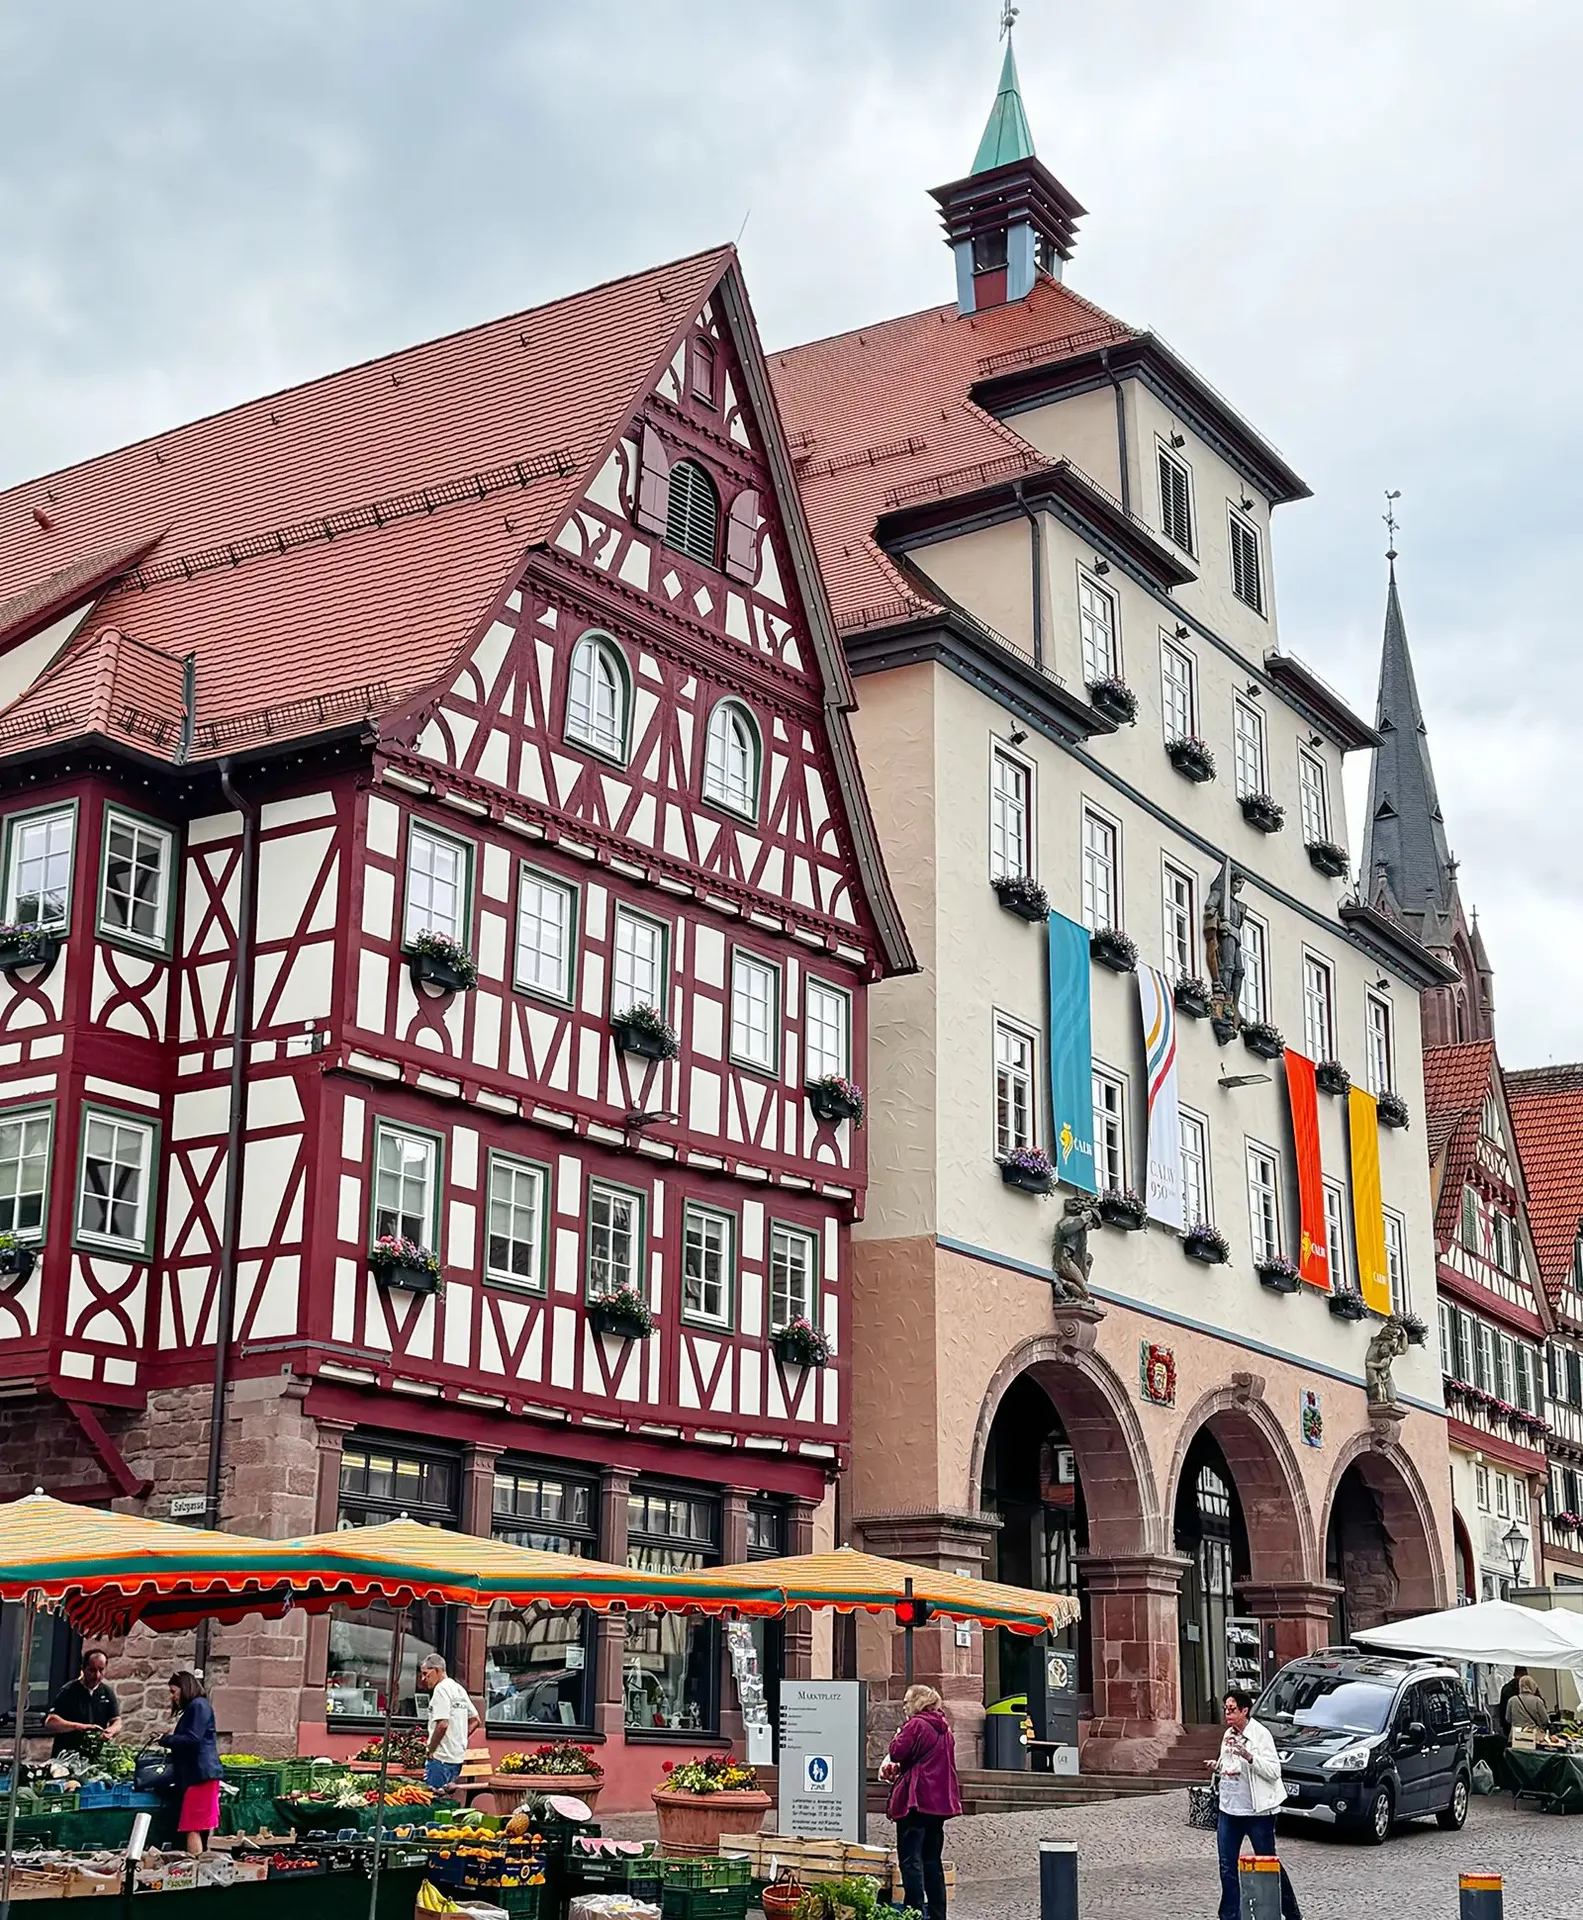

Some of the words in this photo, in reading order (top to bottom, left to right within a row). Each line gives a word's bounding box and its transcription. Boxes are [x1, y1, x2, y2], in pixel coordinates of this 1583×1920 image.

[1073, 1137, 1093, 1156] CALW
[1150, 1159, 1175, 1184] CALW
[1151, 1181, 1168, 1200] 950
[173, 1501, 204, 1513] Salzgasse
